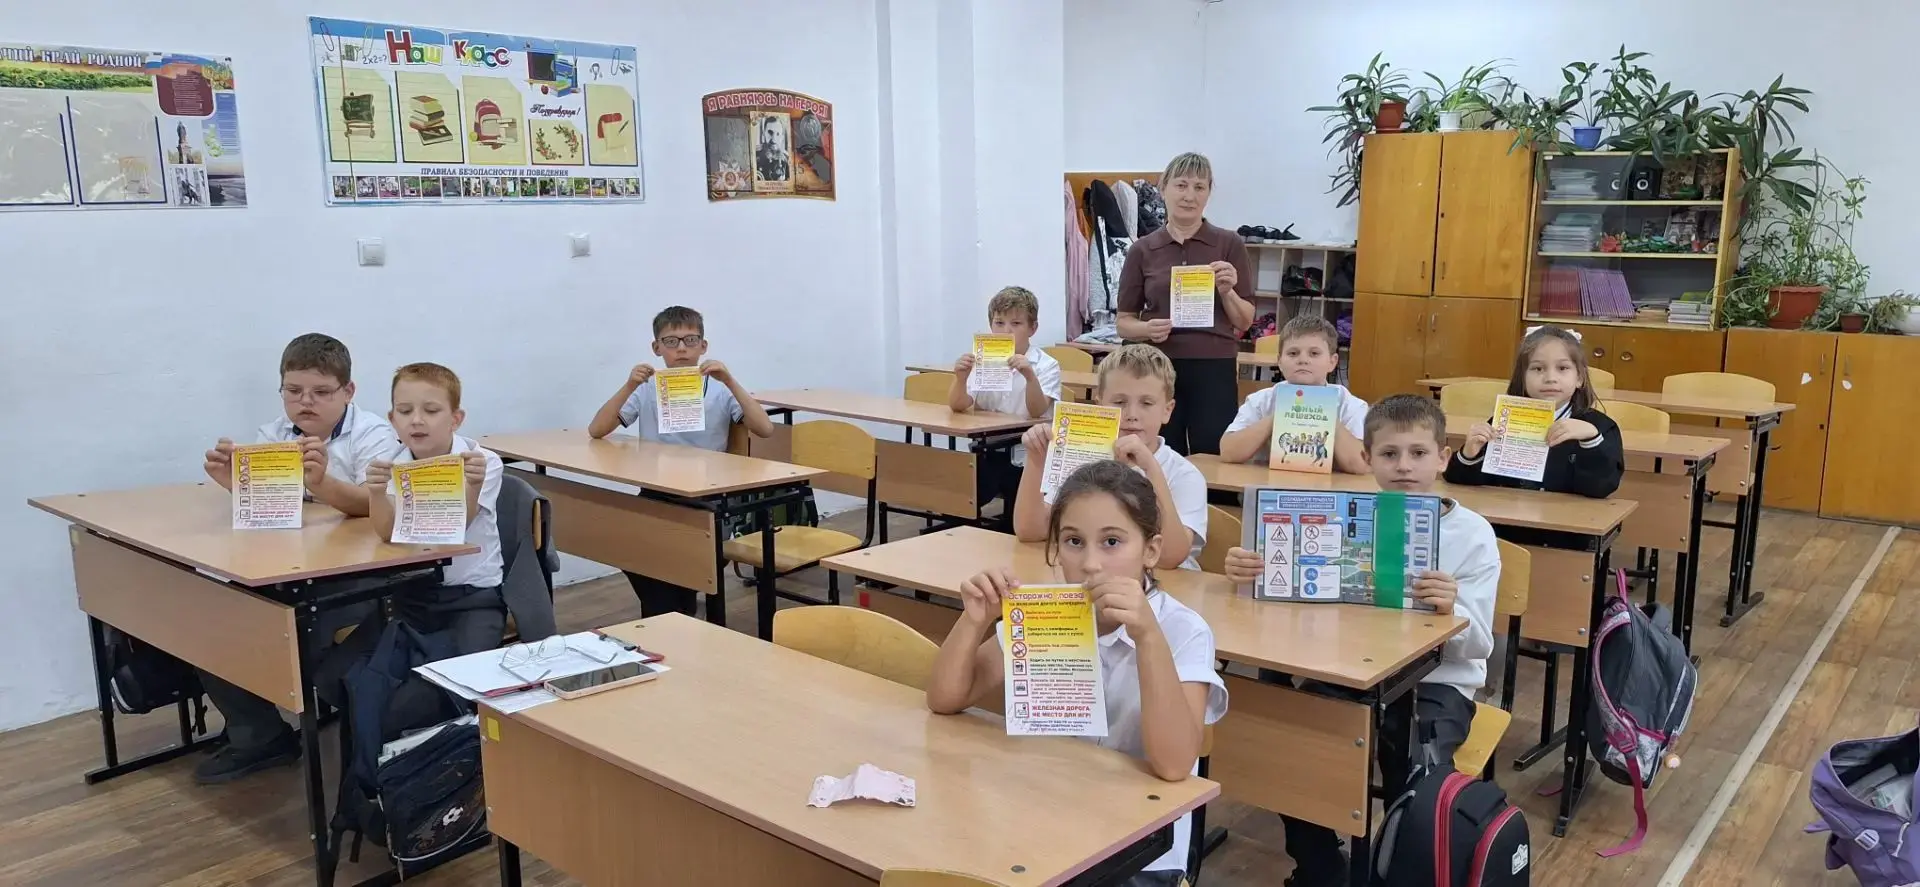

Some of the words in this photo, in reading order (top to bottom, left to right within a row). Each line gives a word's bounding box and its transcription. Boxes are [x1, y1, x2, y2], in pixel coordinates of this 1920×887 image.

[0, 46, 34, 62] ЧИЙ
[41, 50, 80, 65] КРАЙ
[87, 52, 142, 67] РОДНОЙ
[386, 29, 443, 66] Наш
[707, 96, 718, 112] Я
[718, 92, 777, 111] РАВНЯЮСЬ
[779, 93, 795, 108] НА
[795, 98, 829, 118] ГЕРОЯ!
[421, 168, 457, 176] ПРАВИЛА
[459, 168, 518, 176] БЕЗОПАСНОСТИ
[519, 168, 525, 176] И
[526, 169, 569, 177] ПОВЕДЕНИЯ
